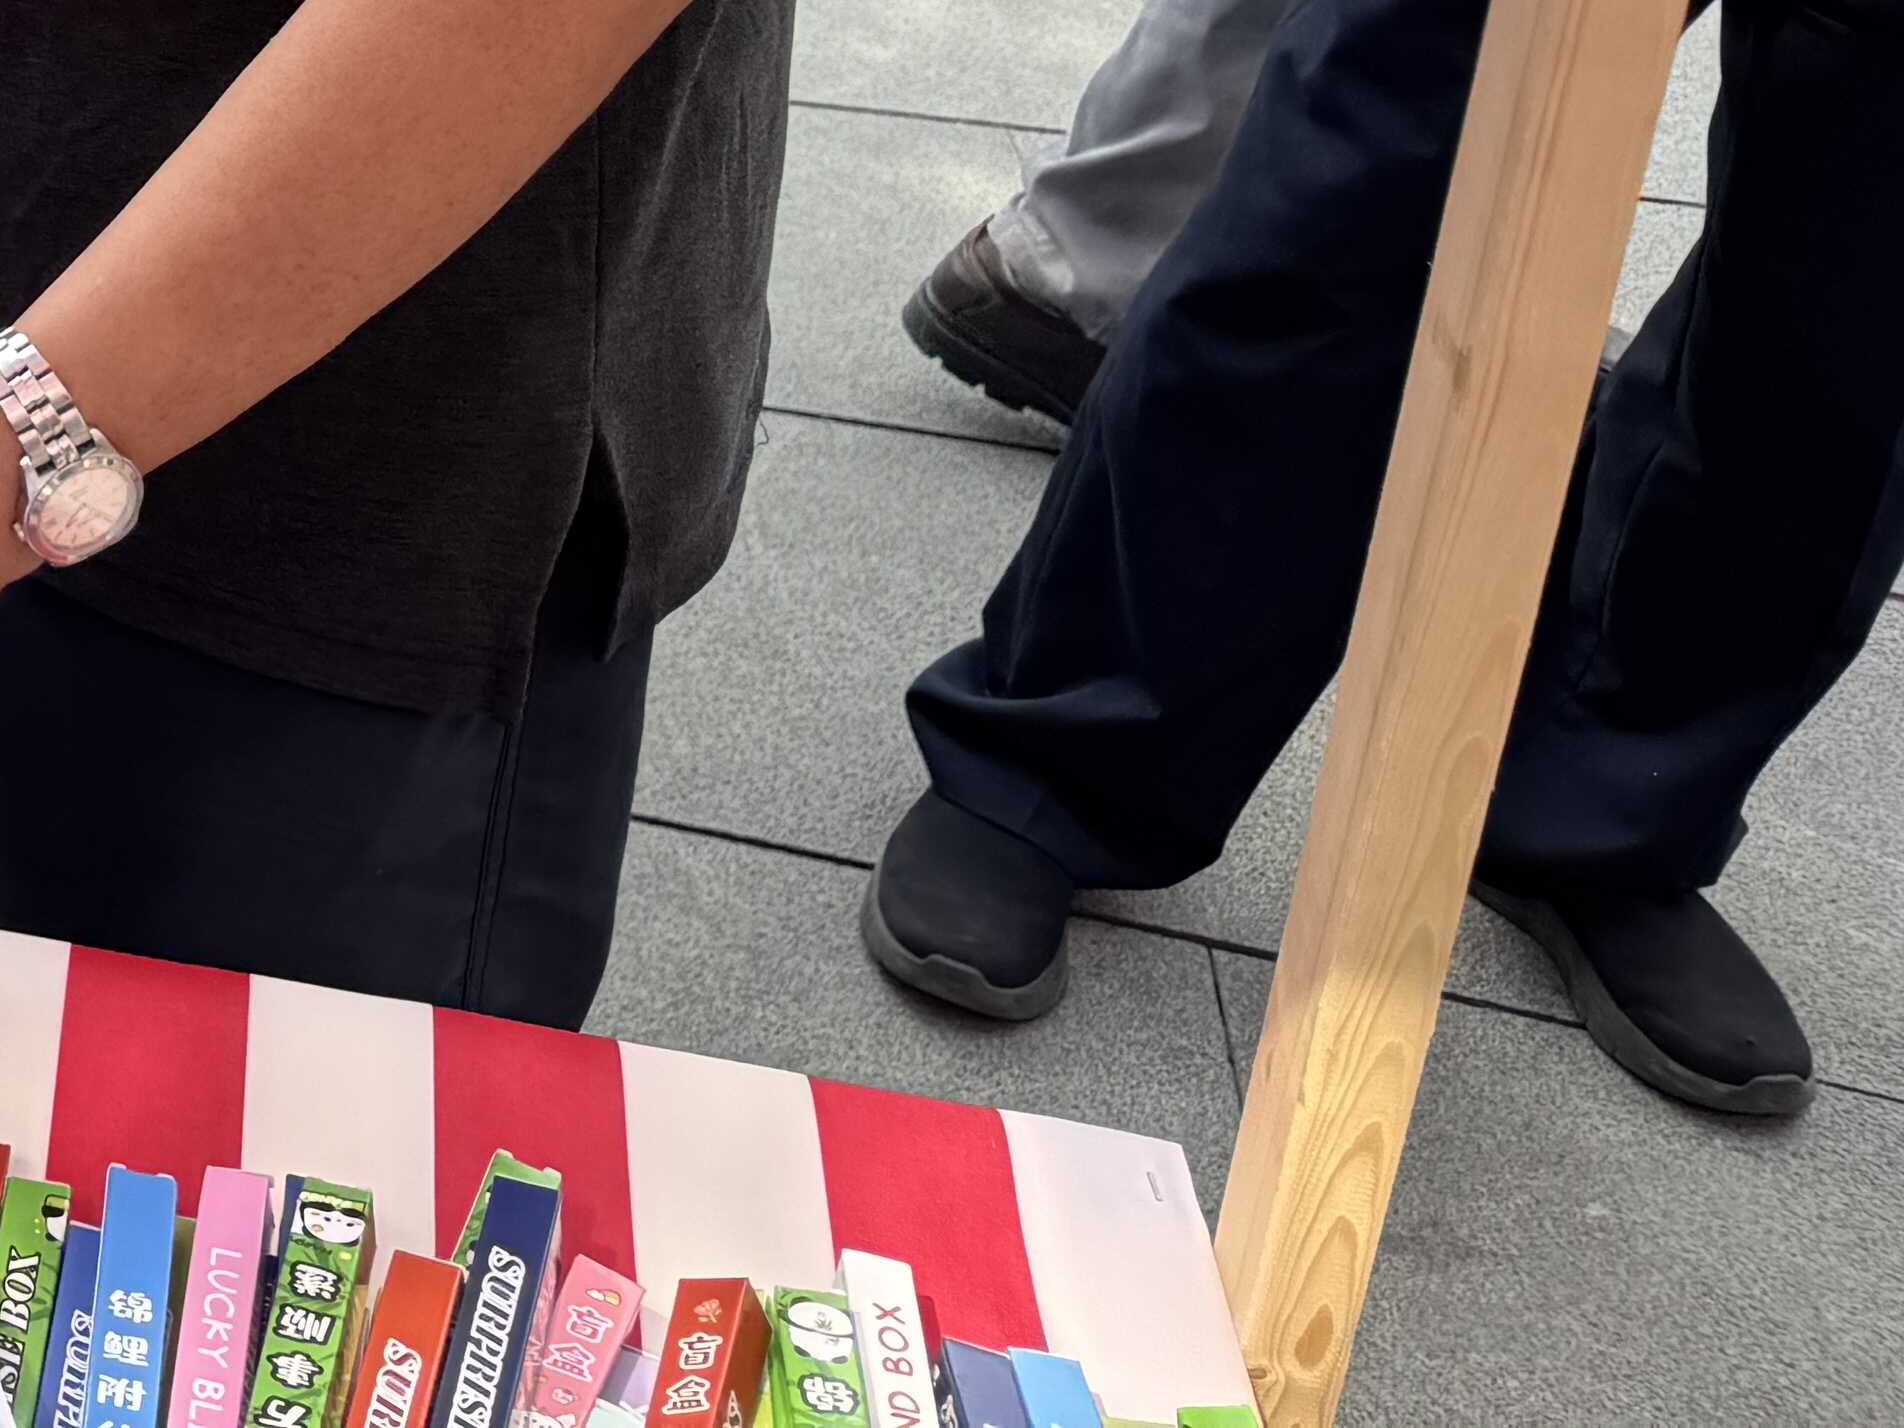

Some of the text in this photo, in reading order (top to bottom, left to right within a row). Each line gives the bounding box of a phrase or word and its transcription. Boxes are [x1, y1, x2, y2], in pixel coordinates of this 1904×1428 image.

[95, 1288, 154, 1428] 锦鲤附
[181, 1247, 243, 1428] LUCKY BL
[259, 1262, 342, 1428] 万事顺遂
[543, 1306, 614, 1383] 盲盒
[662, 1331, 723, 1414] 盲盒
[875, 1301, 911, 1376] BOX
